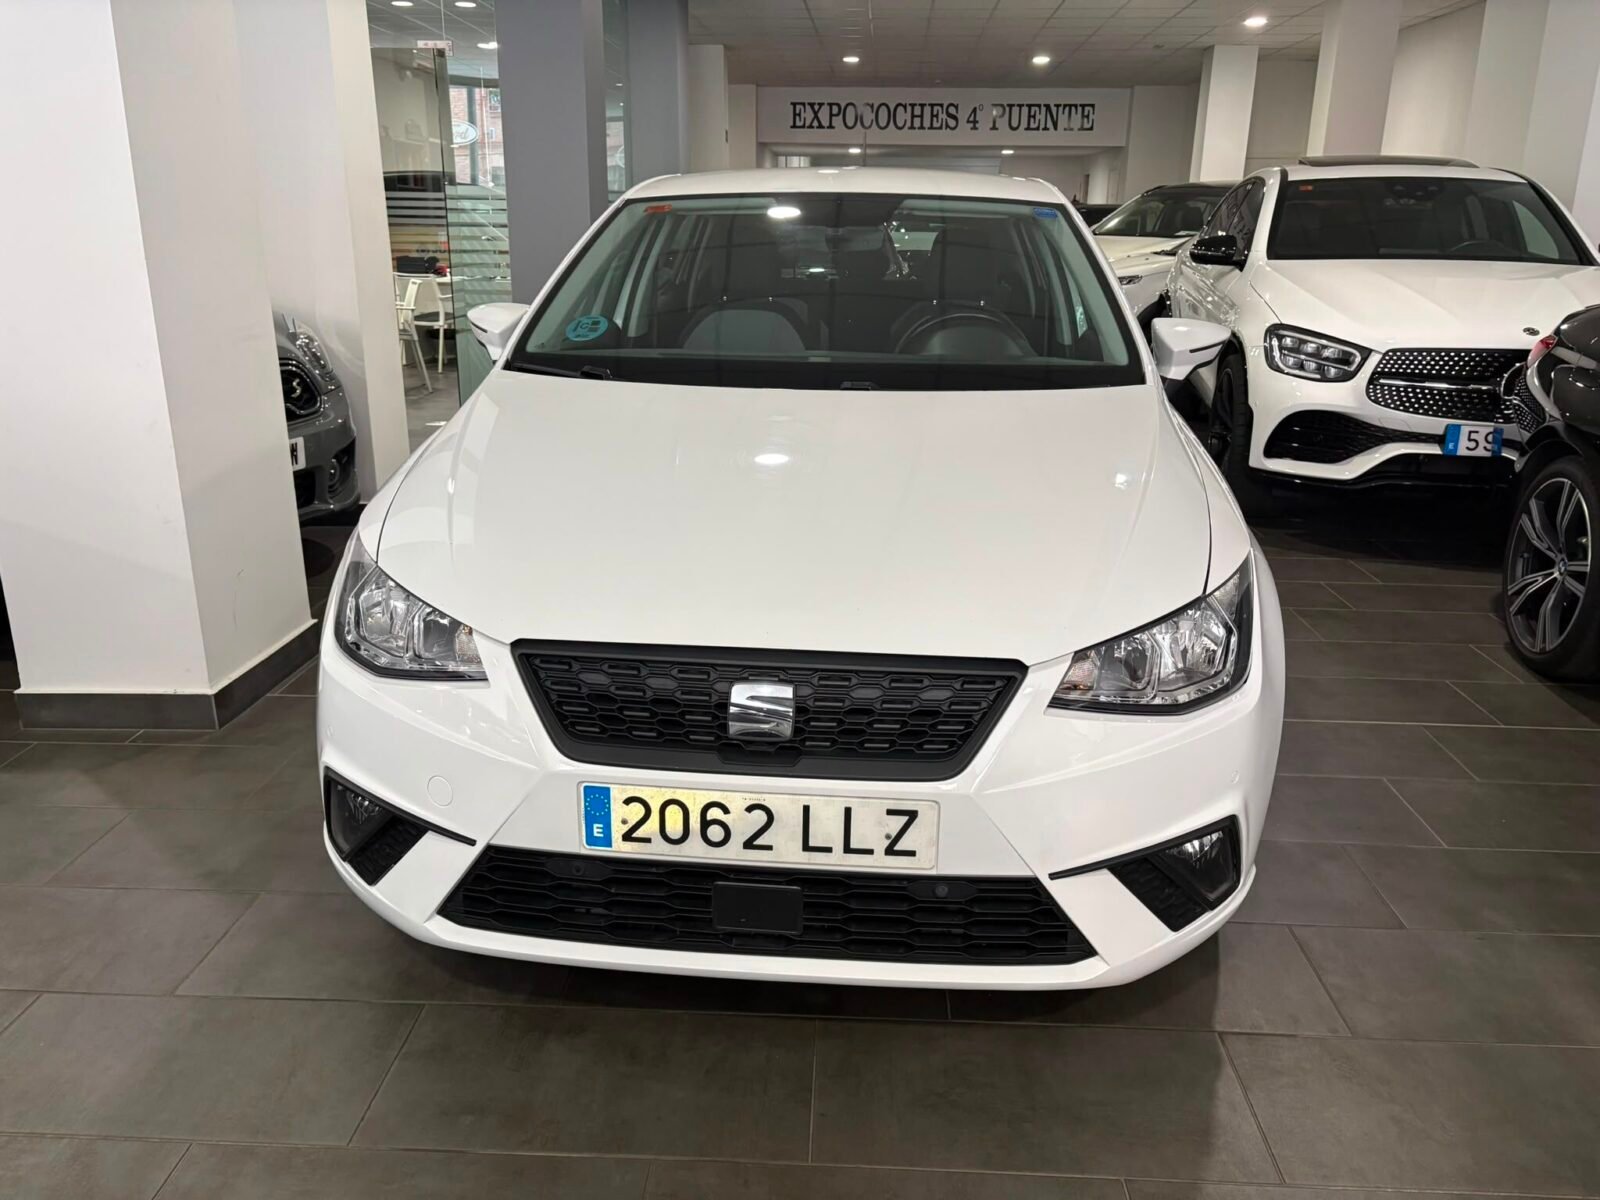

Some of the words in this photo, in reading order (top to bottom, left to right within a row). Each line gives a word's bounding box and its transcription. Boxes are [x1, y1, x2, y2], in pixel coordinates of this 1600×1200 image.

[790, 102, 959, 131] EXPOCOCHES
[989, 103, 1096, 132] PUENTE
[592, 823, 604, 837] E
[621, 795, 775, 852] 2062
[801, 804, 920, 858] LLZ
